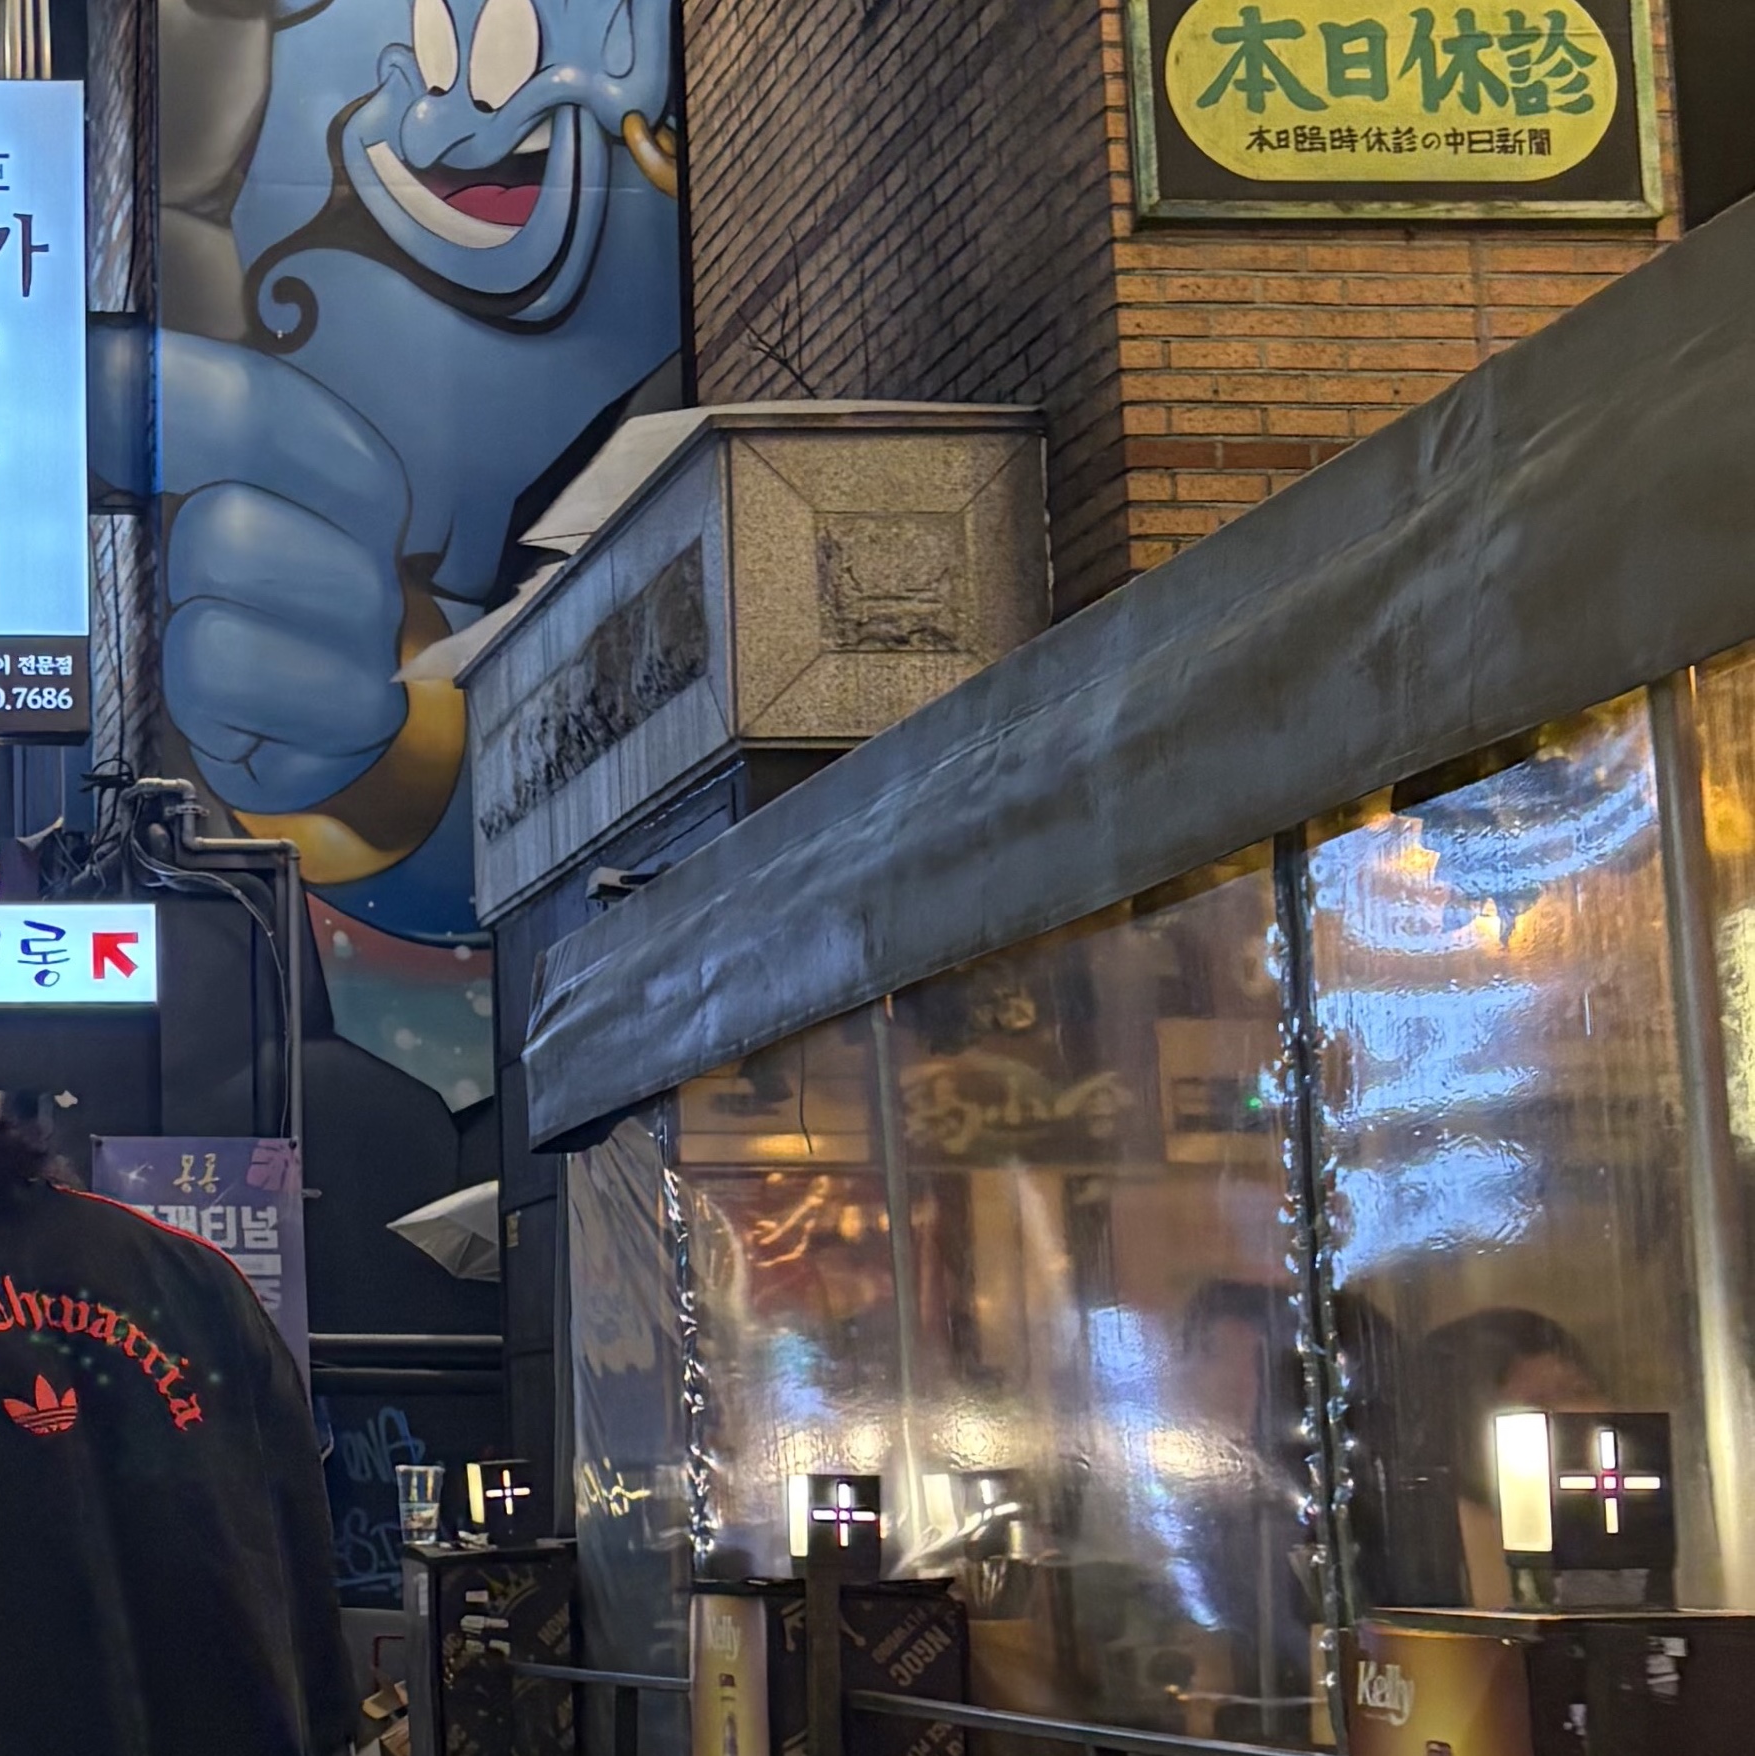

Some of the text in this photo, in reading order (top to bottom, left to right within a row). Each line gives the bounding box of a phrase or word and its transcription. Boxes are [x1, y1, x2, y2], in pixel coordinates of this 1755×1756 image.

[1197, 6, 1597, 116] 本日休診
[1246, 125, 1551, 156] 本日臨時休診の中日新聞
[17, 654, 73, 676] 전문점
[889, 1623, 952, 1687] NGOC
[1357, 1660, 1415, 1727] Kelly
